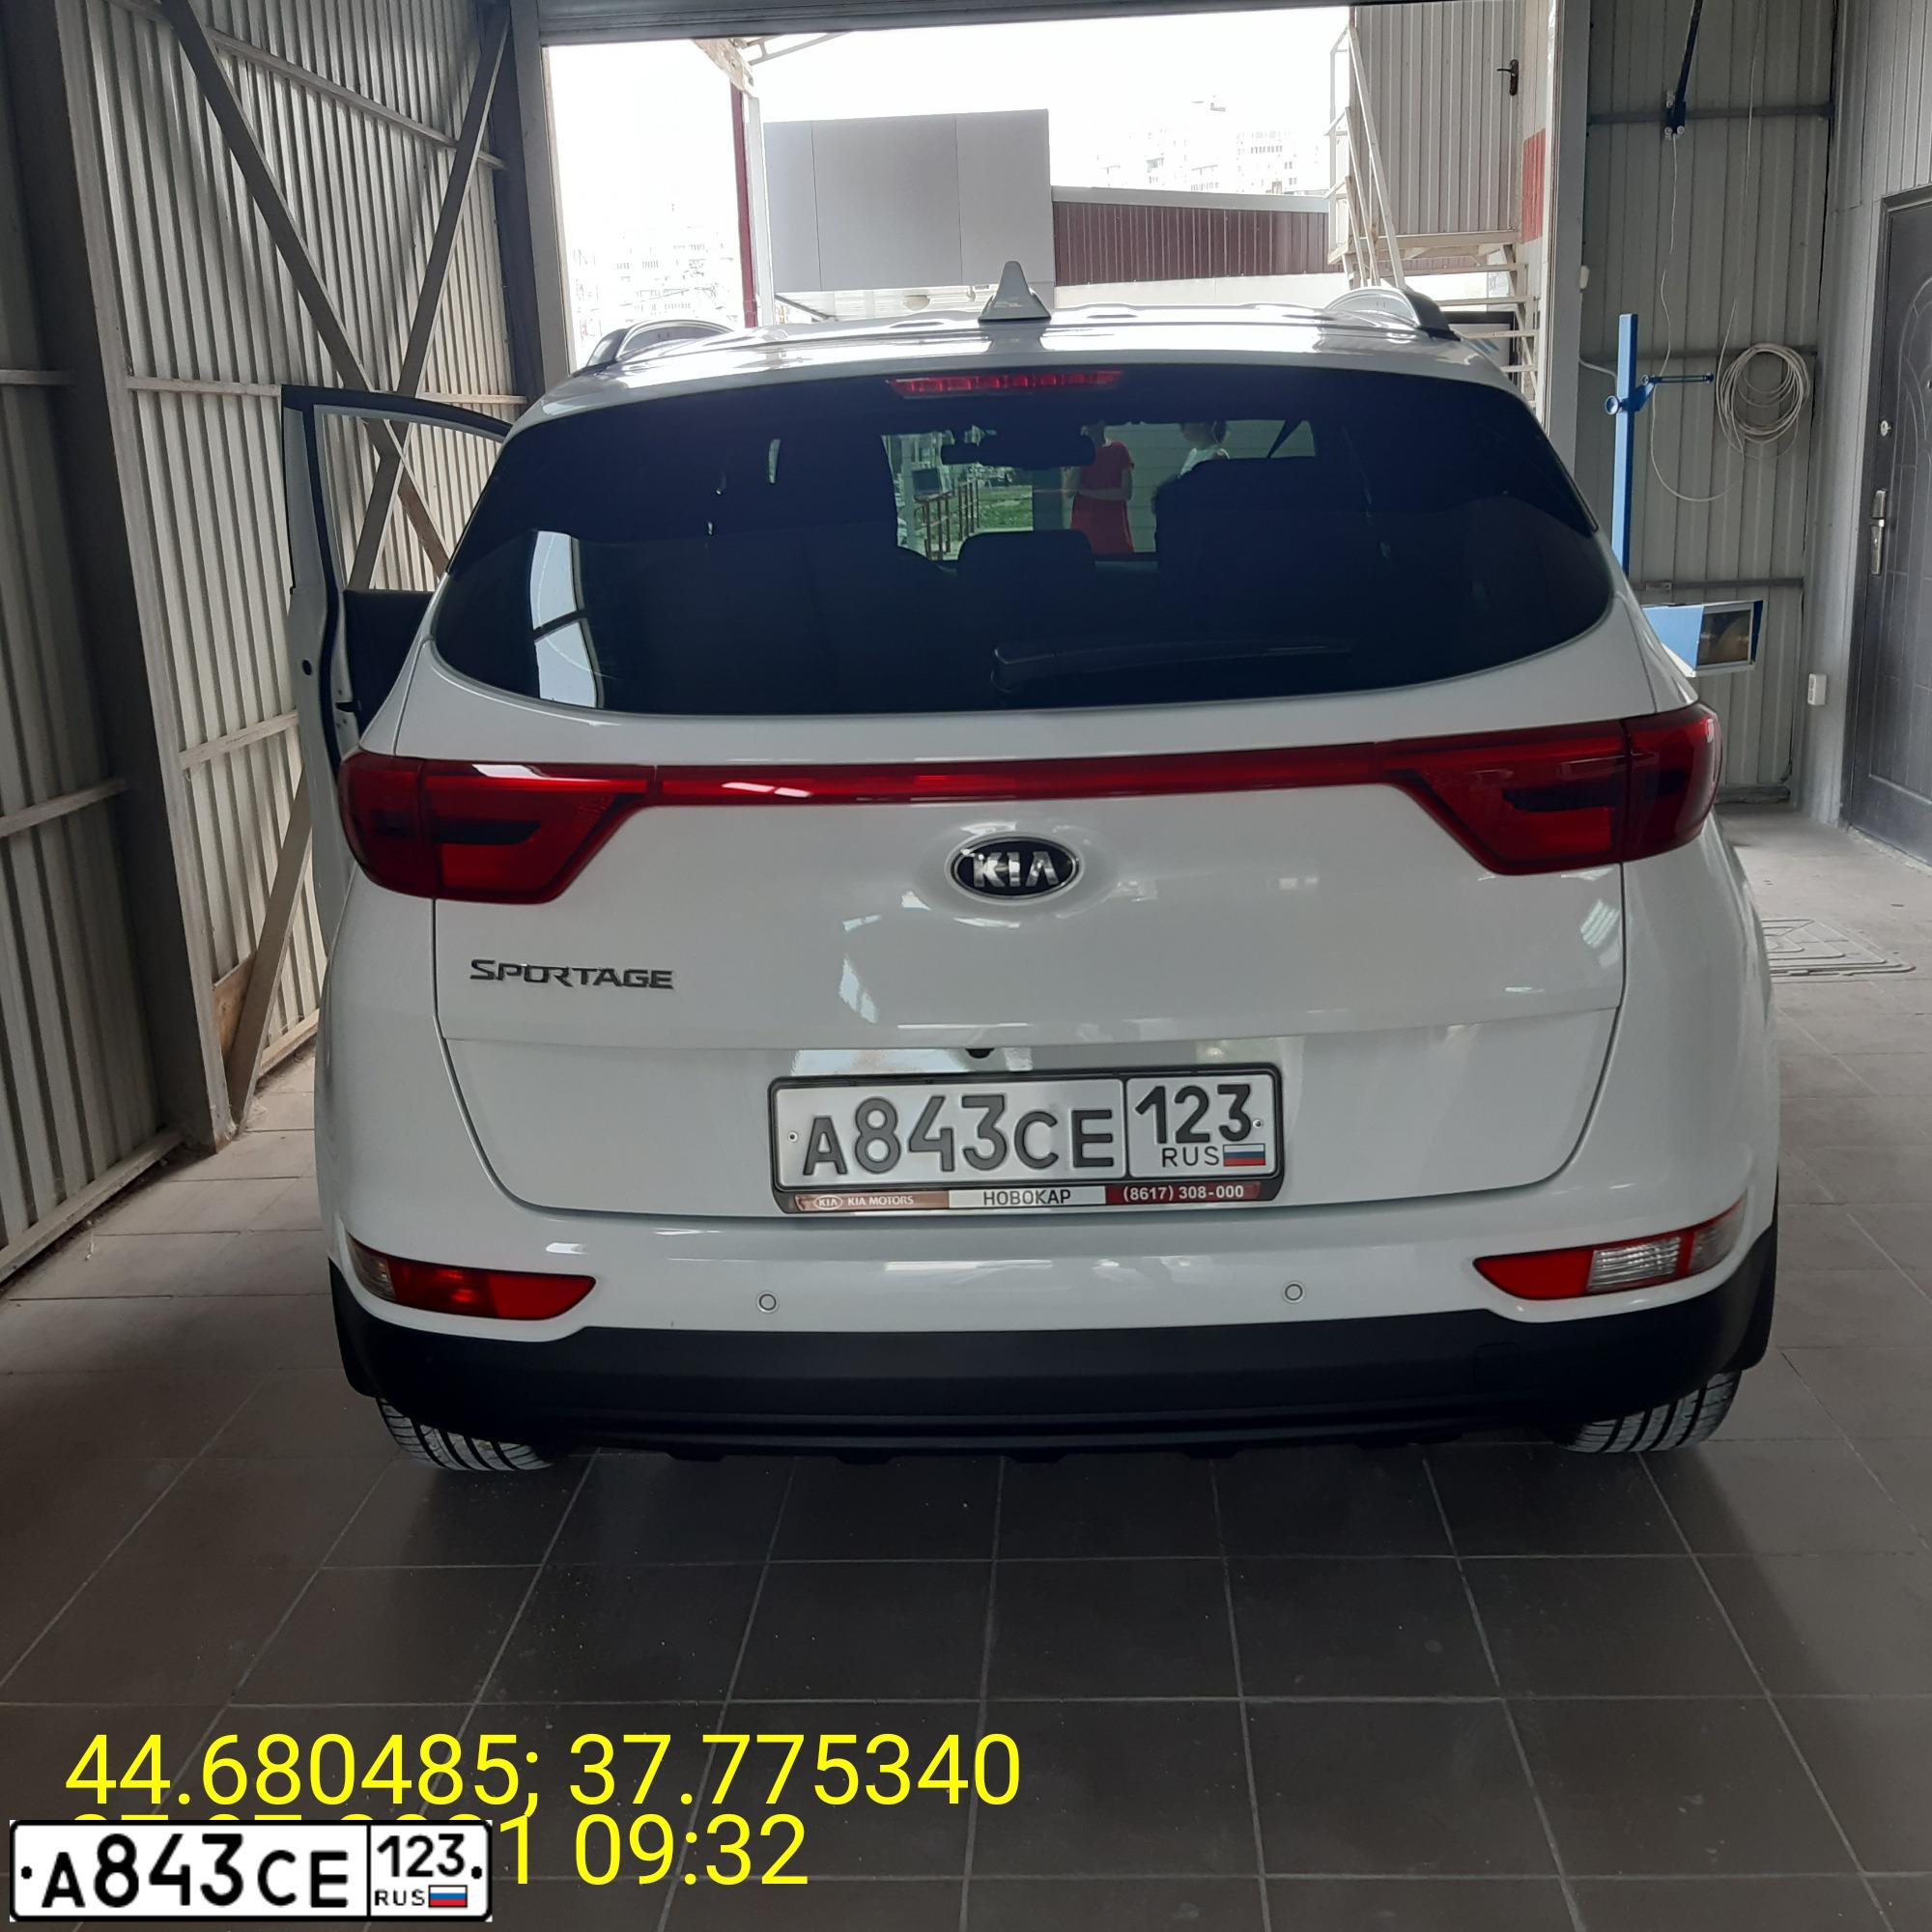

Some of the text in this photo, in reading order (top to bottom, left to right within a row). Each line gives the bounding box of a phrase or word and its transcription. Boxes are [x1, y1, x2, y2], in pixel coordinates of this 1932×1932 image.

[973, 851, 1059, 888] KIA
[469, 959, 674, 989] SPORTAGE
[1134, 1083, 1251, 1144] 123
[1161, 1145, 1220, 1168] RUS
[847, 1195, 914, 1207] KIA MOTORS
[982, 1189, 1071, 1207] НОВОКАР
[1122, 1184, 1244, 1202] (8617) 308-000
